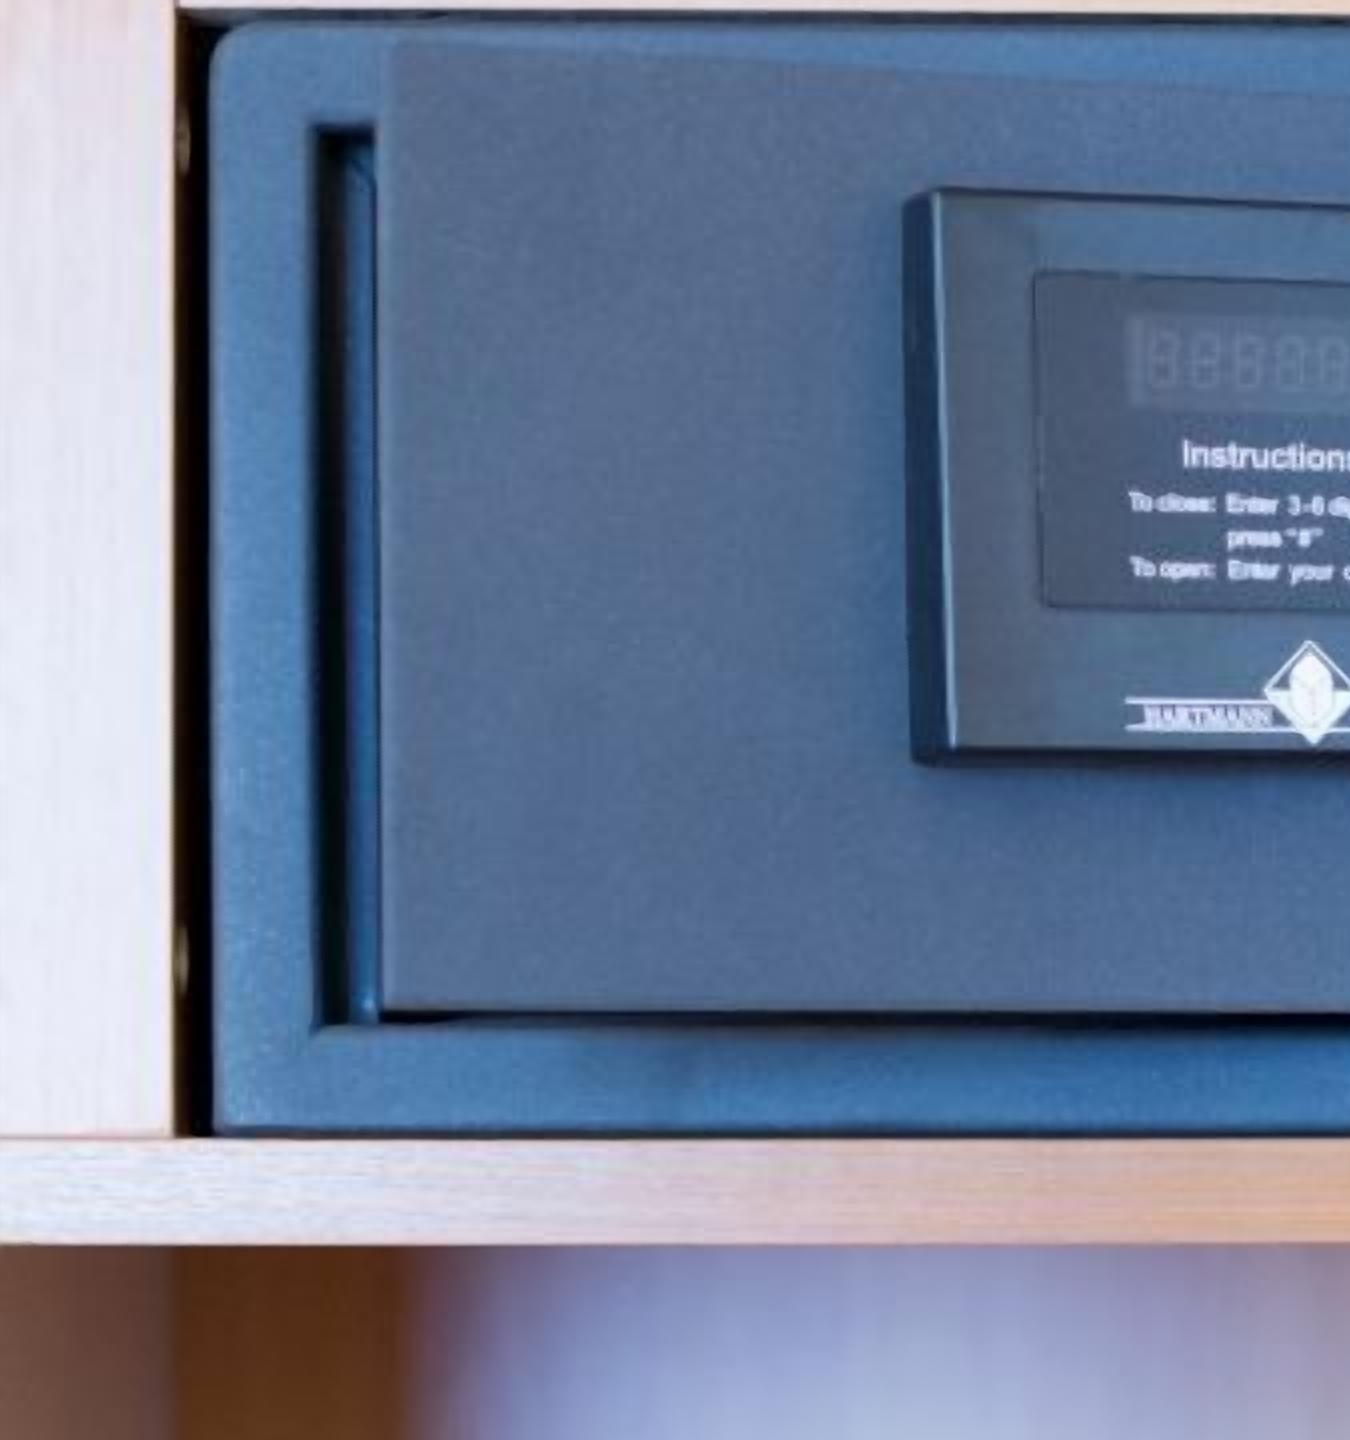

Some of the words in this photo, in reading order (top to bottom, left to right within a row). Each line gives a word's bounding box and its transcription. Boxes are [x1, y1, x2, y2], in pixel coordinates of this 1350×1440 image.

[1128, 490, 1153, 512] To
[1225, 492, 1279, 515] Enter
[1226, 529, 1283, 551] press
[1129, 556, 1157, 578] To
[1226, 558, 1281, 581] Enter
[1288, 564, 1334, 586] your
